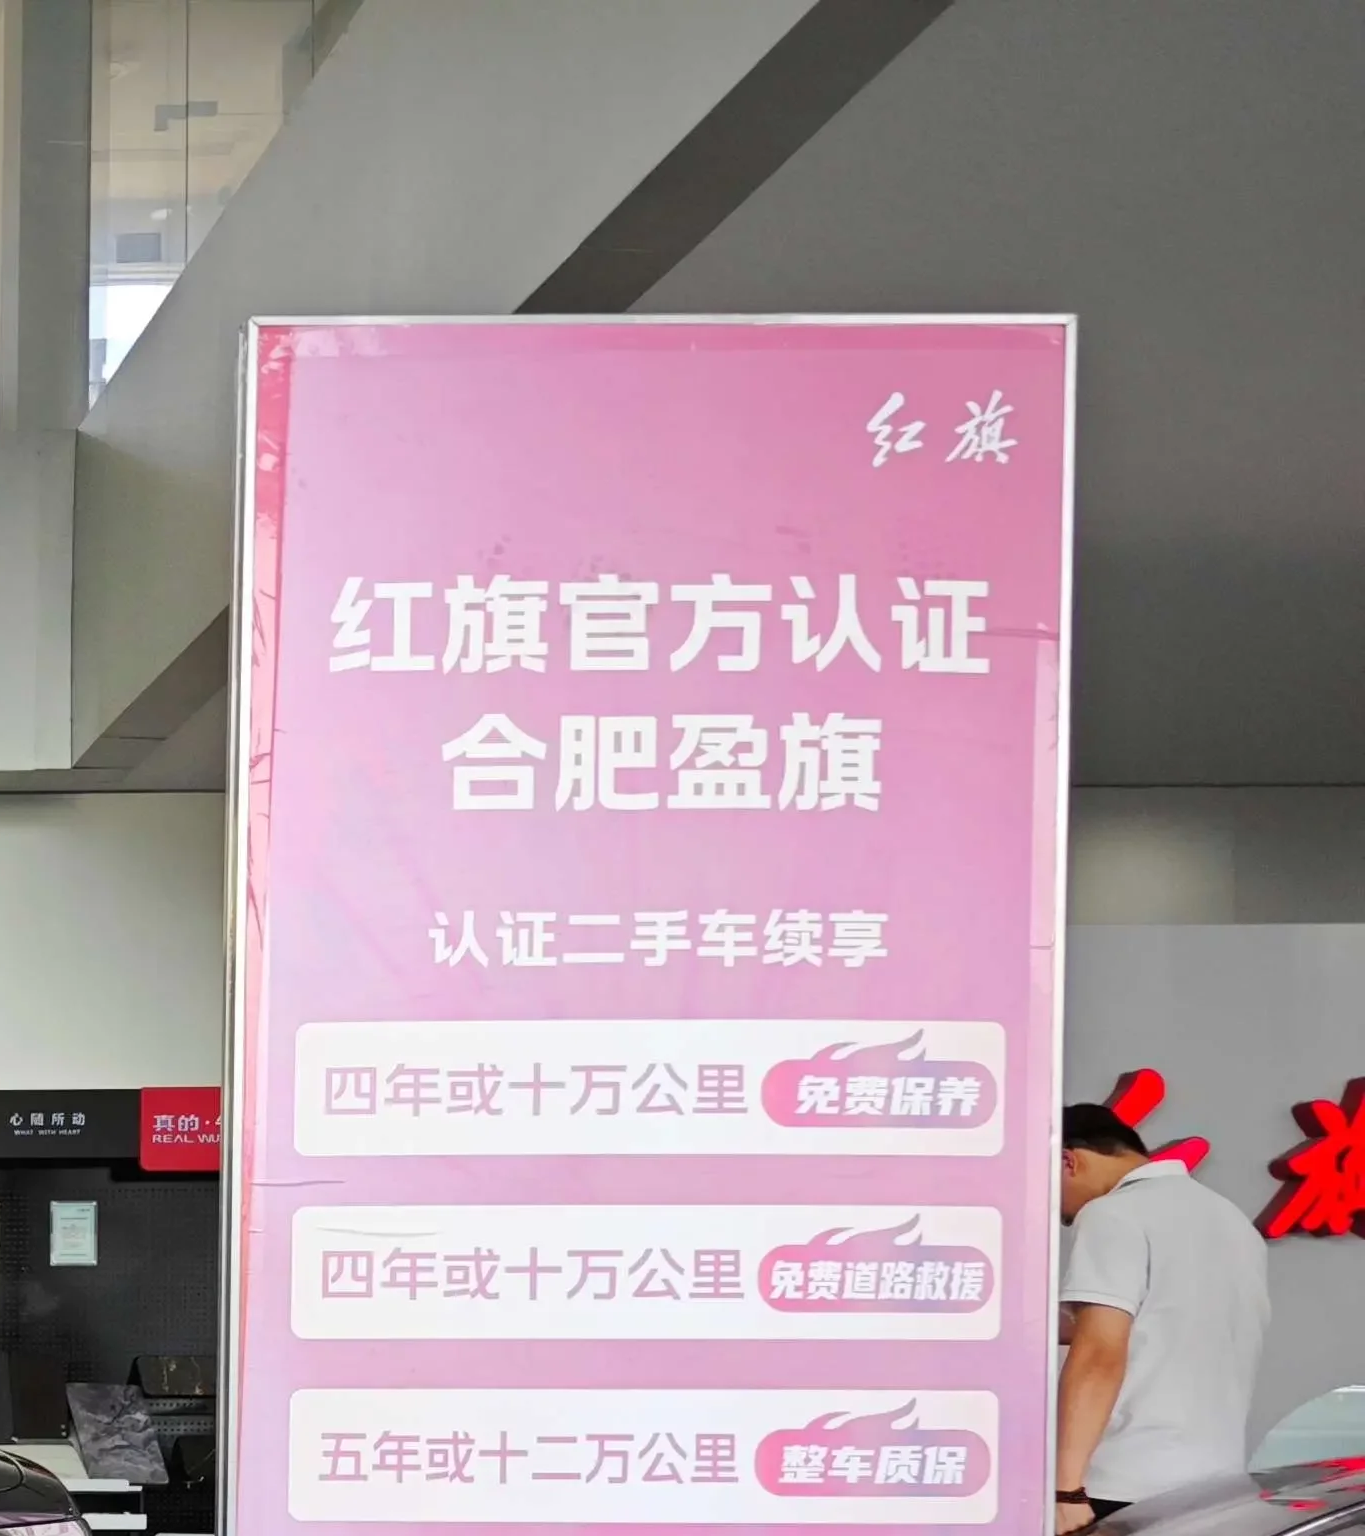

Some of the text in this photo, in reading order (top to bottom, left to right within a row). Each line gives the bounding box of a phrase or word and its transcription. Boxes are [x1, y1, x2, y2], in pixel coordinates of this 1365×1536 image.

[867, 391, 1018, 467] 红旗
[329, 575, 990, 675] 红旗官方认证
[441, 712, 882, 812] 合肥盈旗
[429, 910, 889, 968] 认证二手车续享
[322, 1063, 982, 1117] 四年或十万公里 免费保养
[10, 1112, 85, 1127] 心随所动
[152, 1134, 194, 1144] REAL
[320, 1247, 985, 1304] 四年或十万公里 免费道路救援
[317, 1431, 968, 1487] 五年或十二万公里 整车质保
